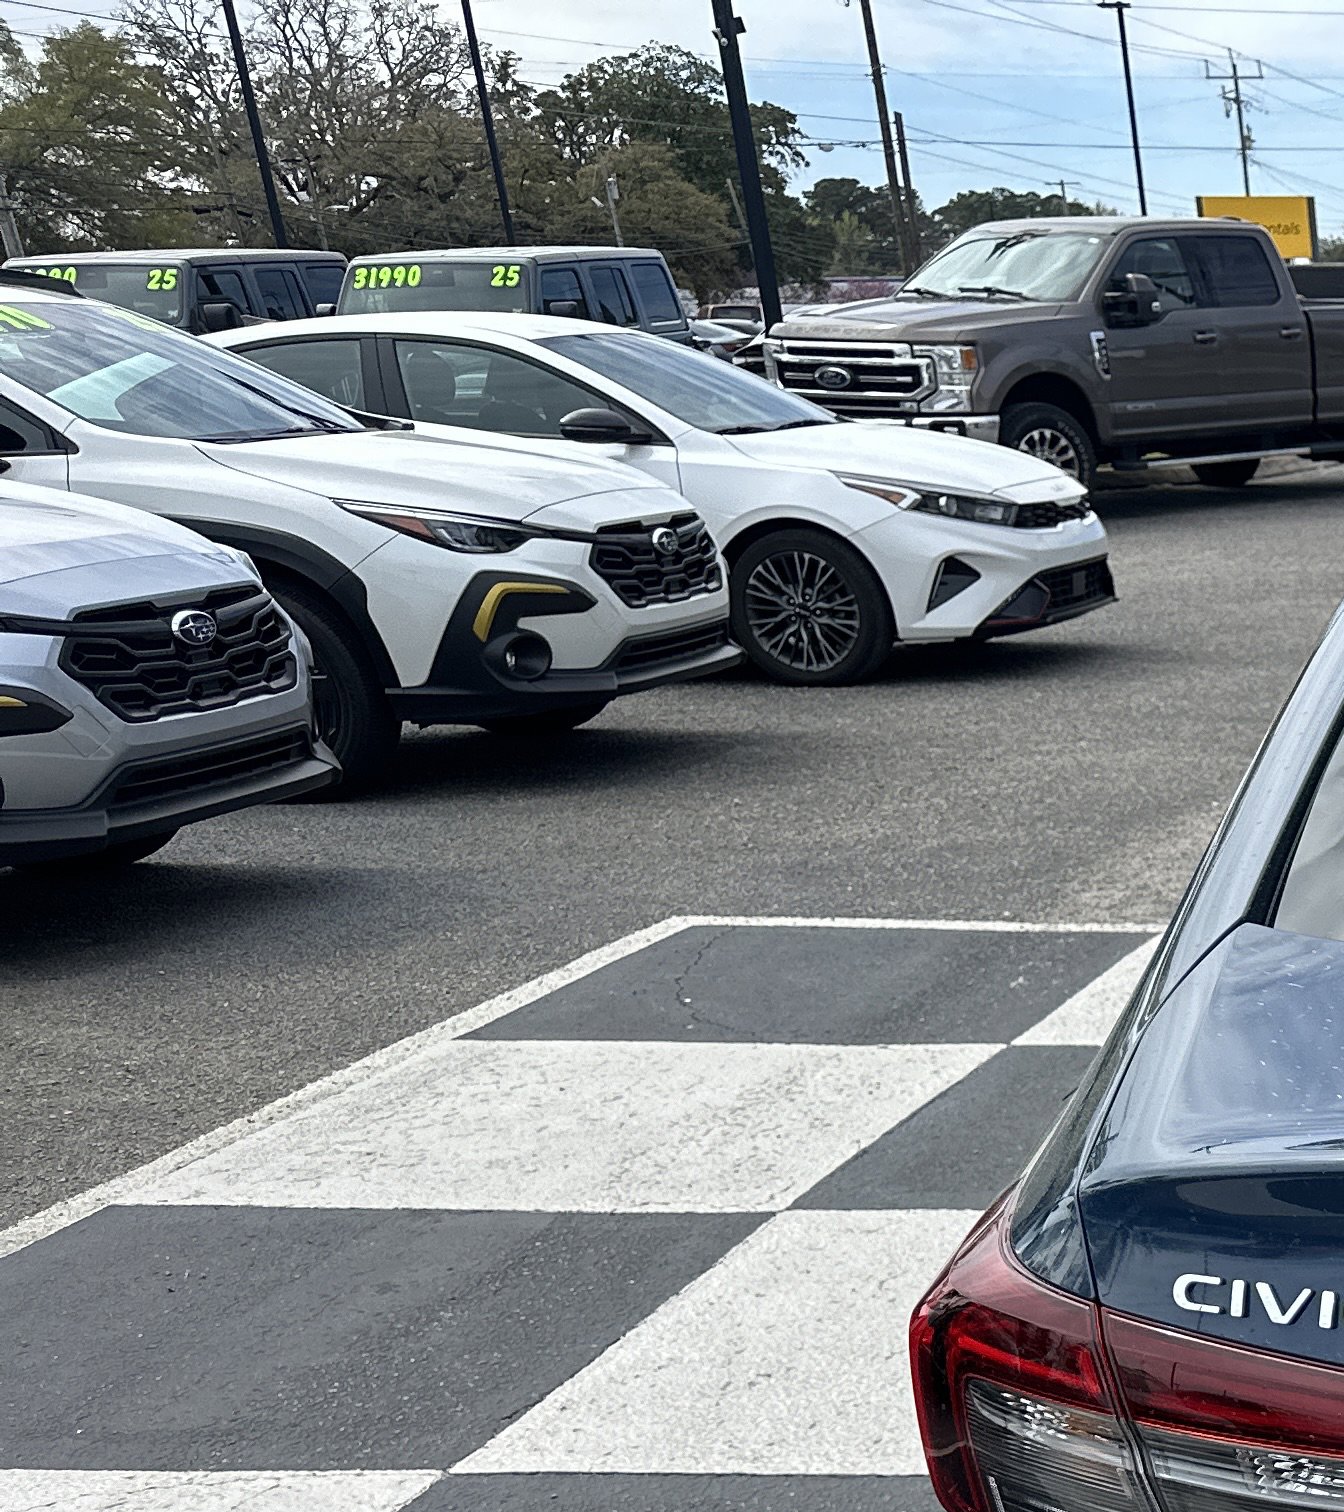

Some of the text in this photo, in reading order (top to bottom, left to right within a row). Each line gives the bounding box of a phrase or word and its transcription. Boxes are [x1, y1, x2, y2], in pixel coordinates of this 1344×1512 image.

[147, 268, 178, 290] 25
[353, 264, 422, 289] 31990
[490, 265, 521, 287] 25
